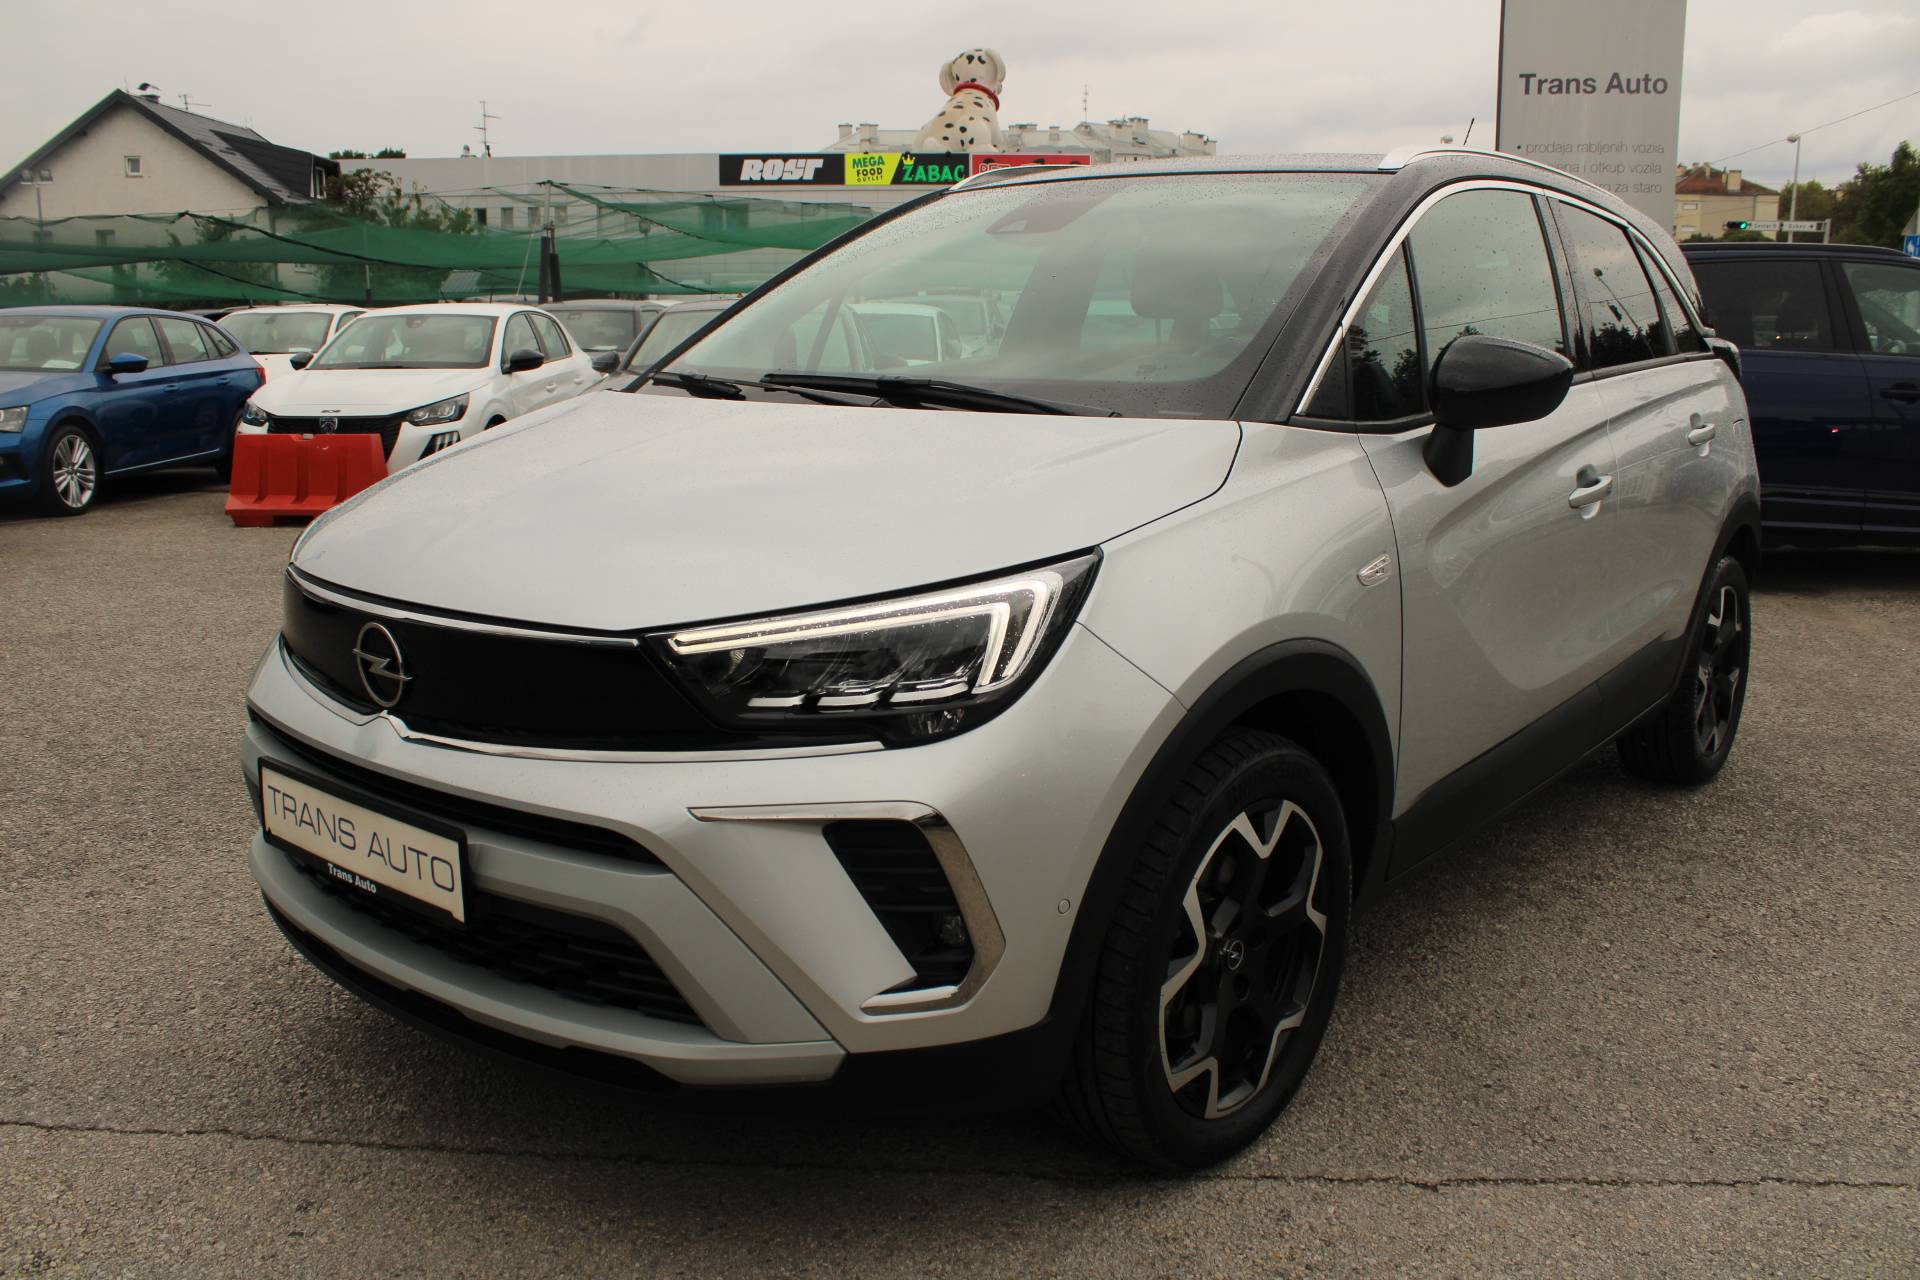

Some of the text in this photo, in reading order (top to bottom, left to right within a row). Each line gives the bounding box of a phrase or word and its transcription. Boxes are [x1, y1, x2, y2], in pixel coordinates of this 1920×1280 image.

[1519, 72, 1668, 95] Trans Auto
[1526, 140, 1664, 155] prodaja rabljenih vozila
[740, 158, 824, 181] ROST
[852, 156, 885, 169] MEGA
[1590, 161, 1625, 175] otkup
[1630, 161, 1662, 173] vozila
[856, 167, 883, 177] FOOD
[856, 175, 883, 183] OUTLET
[1614, 183, 1629, 193] za
[1632, 182, 1662, 193] staro
[267, 785, 455, 893] TRANS AUTO
[327, 863, 377, 894] Trans Auto
